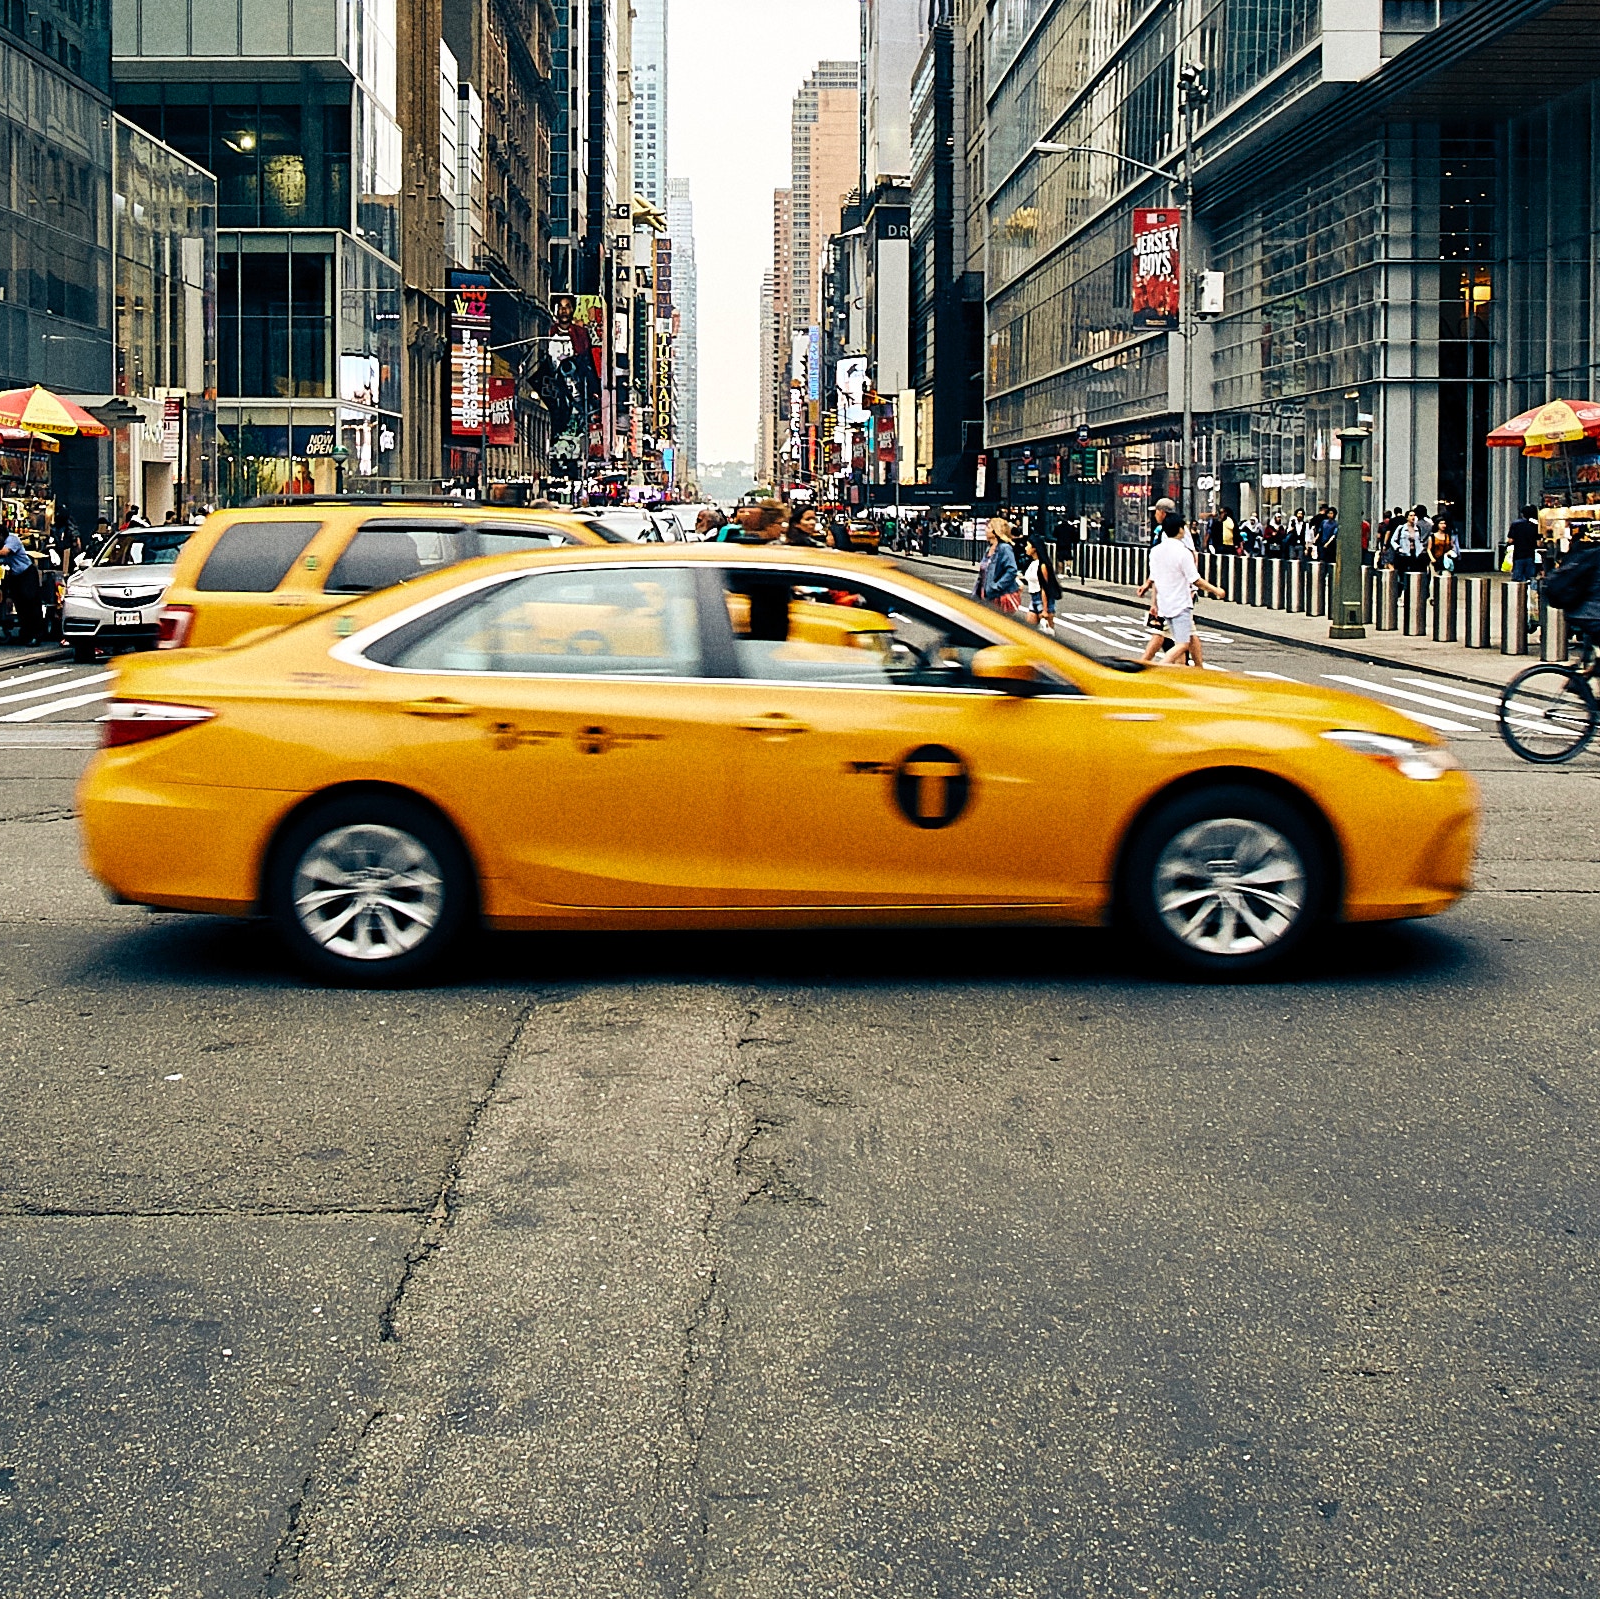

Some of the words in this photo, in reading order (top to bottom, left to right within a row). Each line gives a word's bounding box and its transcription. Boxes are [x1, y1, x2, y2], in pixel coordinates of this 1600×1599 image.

[1134, 228, 1179, 257] JERSEY
[1139, 251, 1172, 276] BOYS
[658, 333, 670, 440] TUSSAUDS
[306, 444, 333, 455] OPEN
[309, 434, 333, 445] NOW
